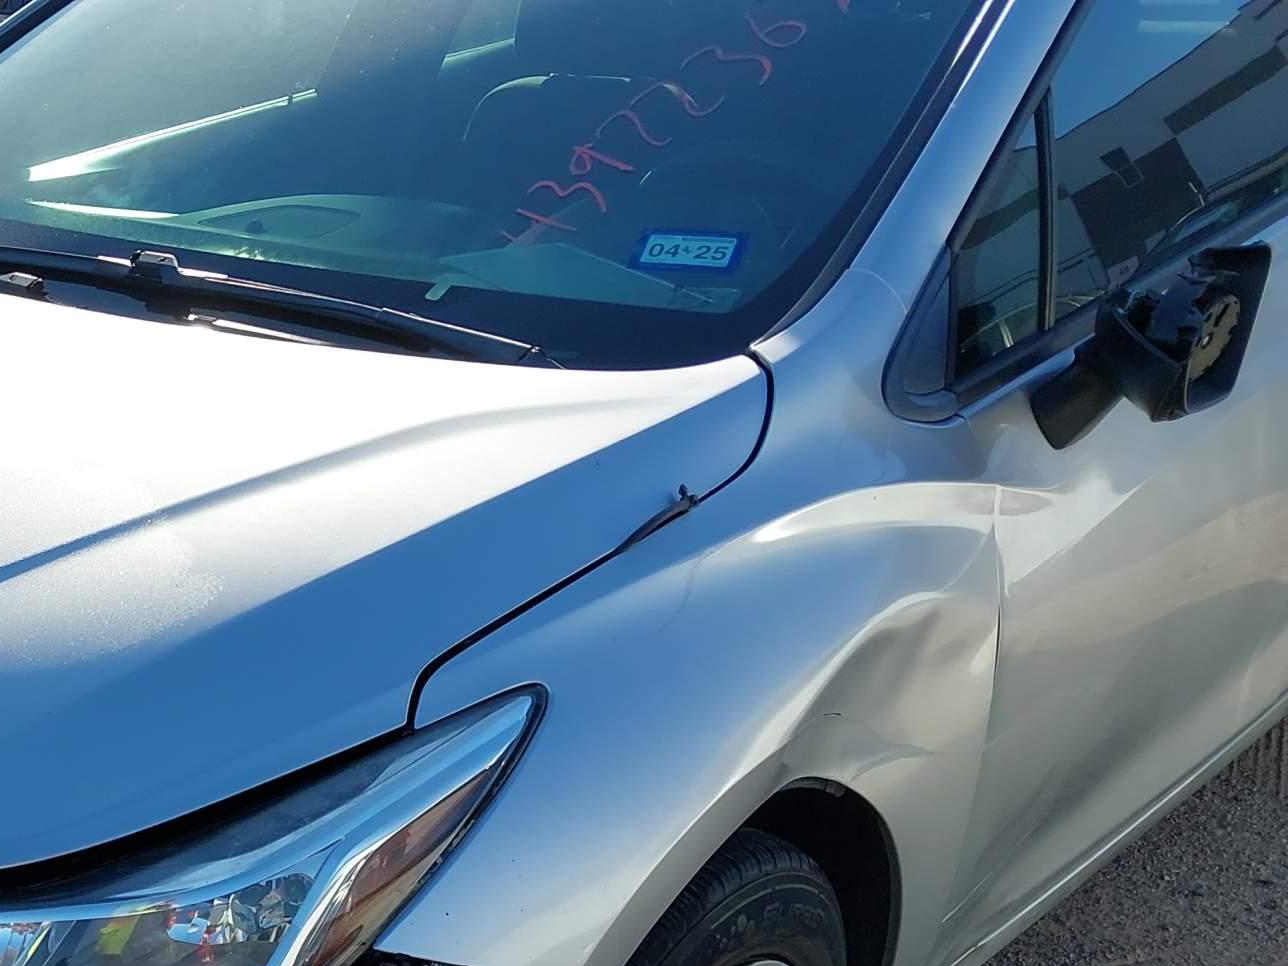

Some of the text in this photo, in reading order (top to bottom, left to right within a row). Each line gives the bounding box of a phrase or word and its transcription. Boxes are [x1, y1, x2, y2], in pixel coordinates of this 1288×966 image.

[499, 0, 850, 245] 4392236
[647, 242, 730, 261] 04 25
